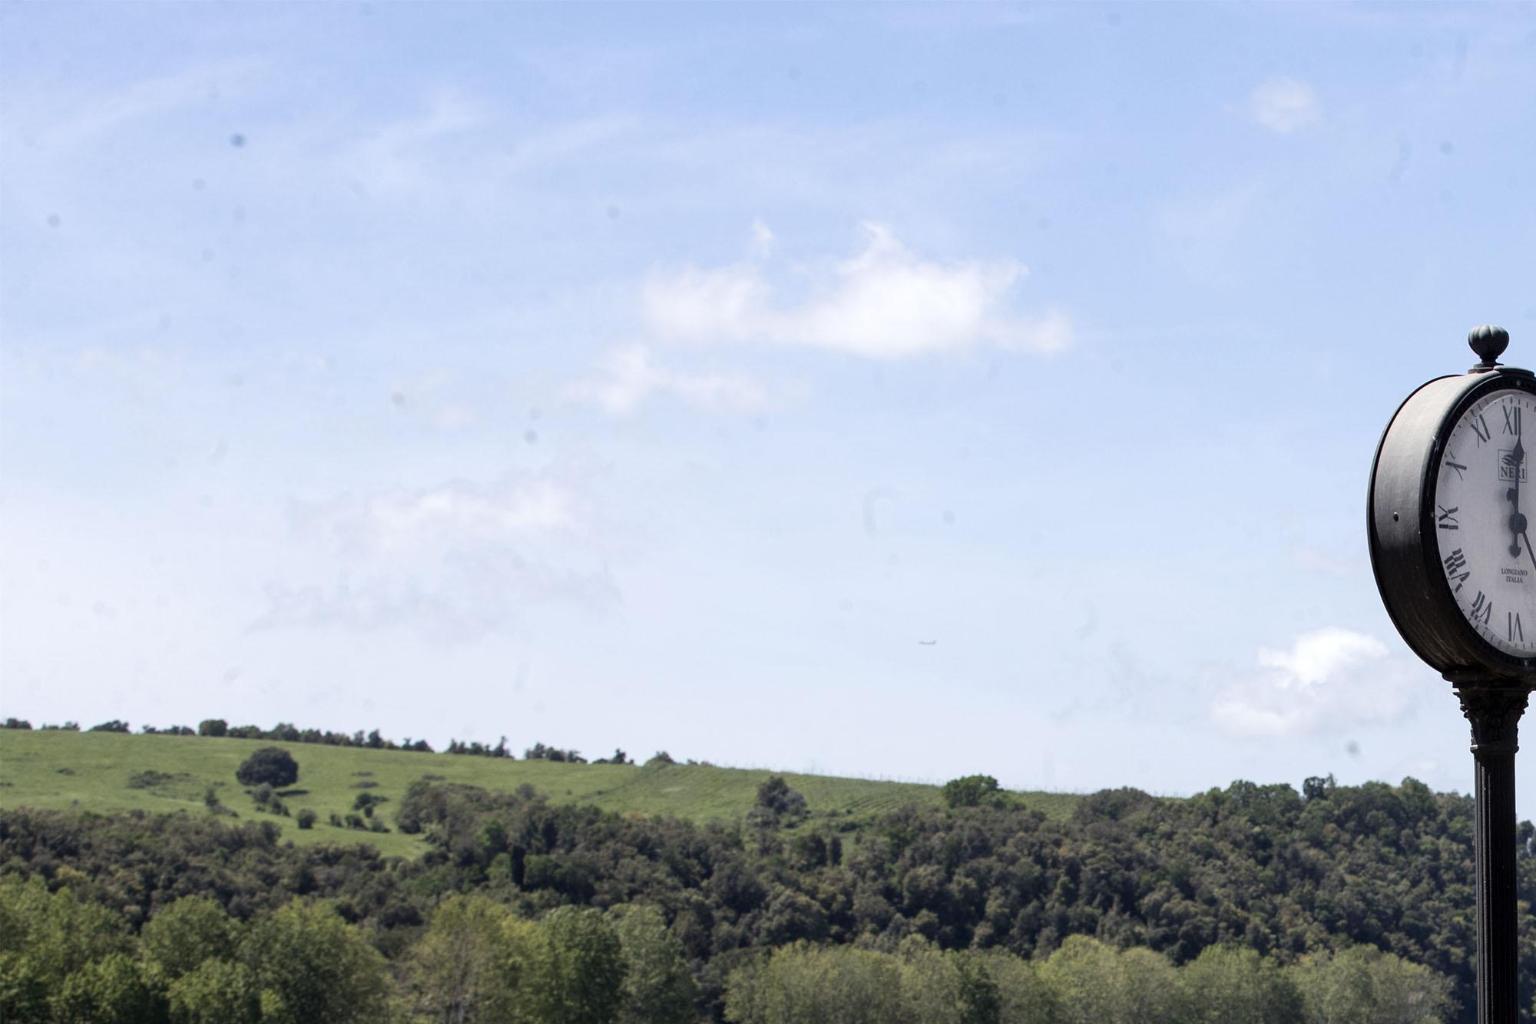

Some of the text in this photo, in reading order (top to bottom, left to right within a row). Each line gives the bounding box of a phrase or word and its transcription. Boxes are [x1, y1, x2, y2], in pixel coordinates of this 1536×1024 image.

[1470, 413, 1491, 448] XI
[1502, 404, 1522, 436] XII
[1445, 450, 1467, 480] X
[1500, 466, 1525, 479] NEI
[1438, 505, 1459, 530] IX
[1444, 548, 1470, 592] VIII
[1471, 590, 1493, 625] VII
[1508, 611, 1524, 642] VI
